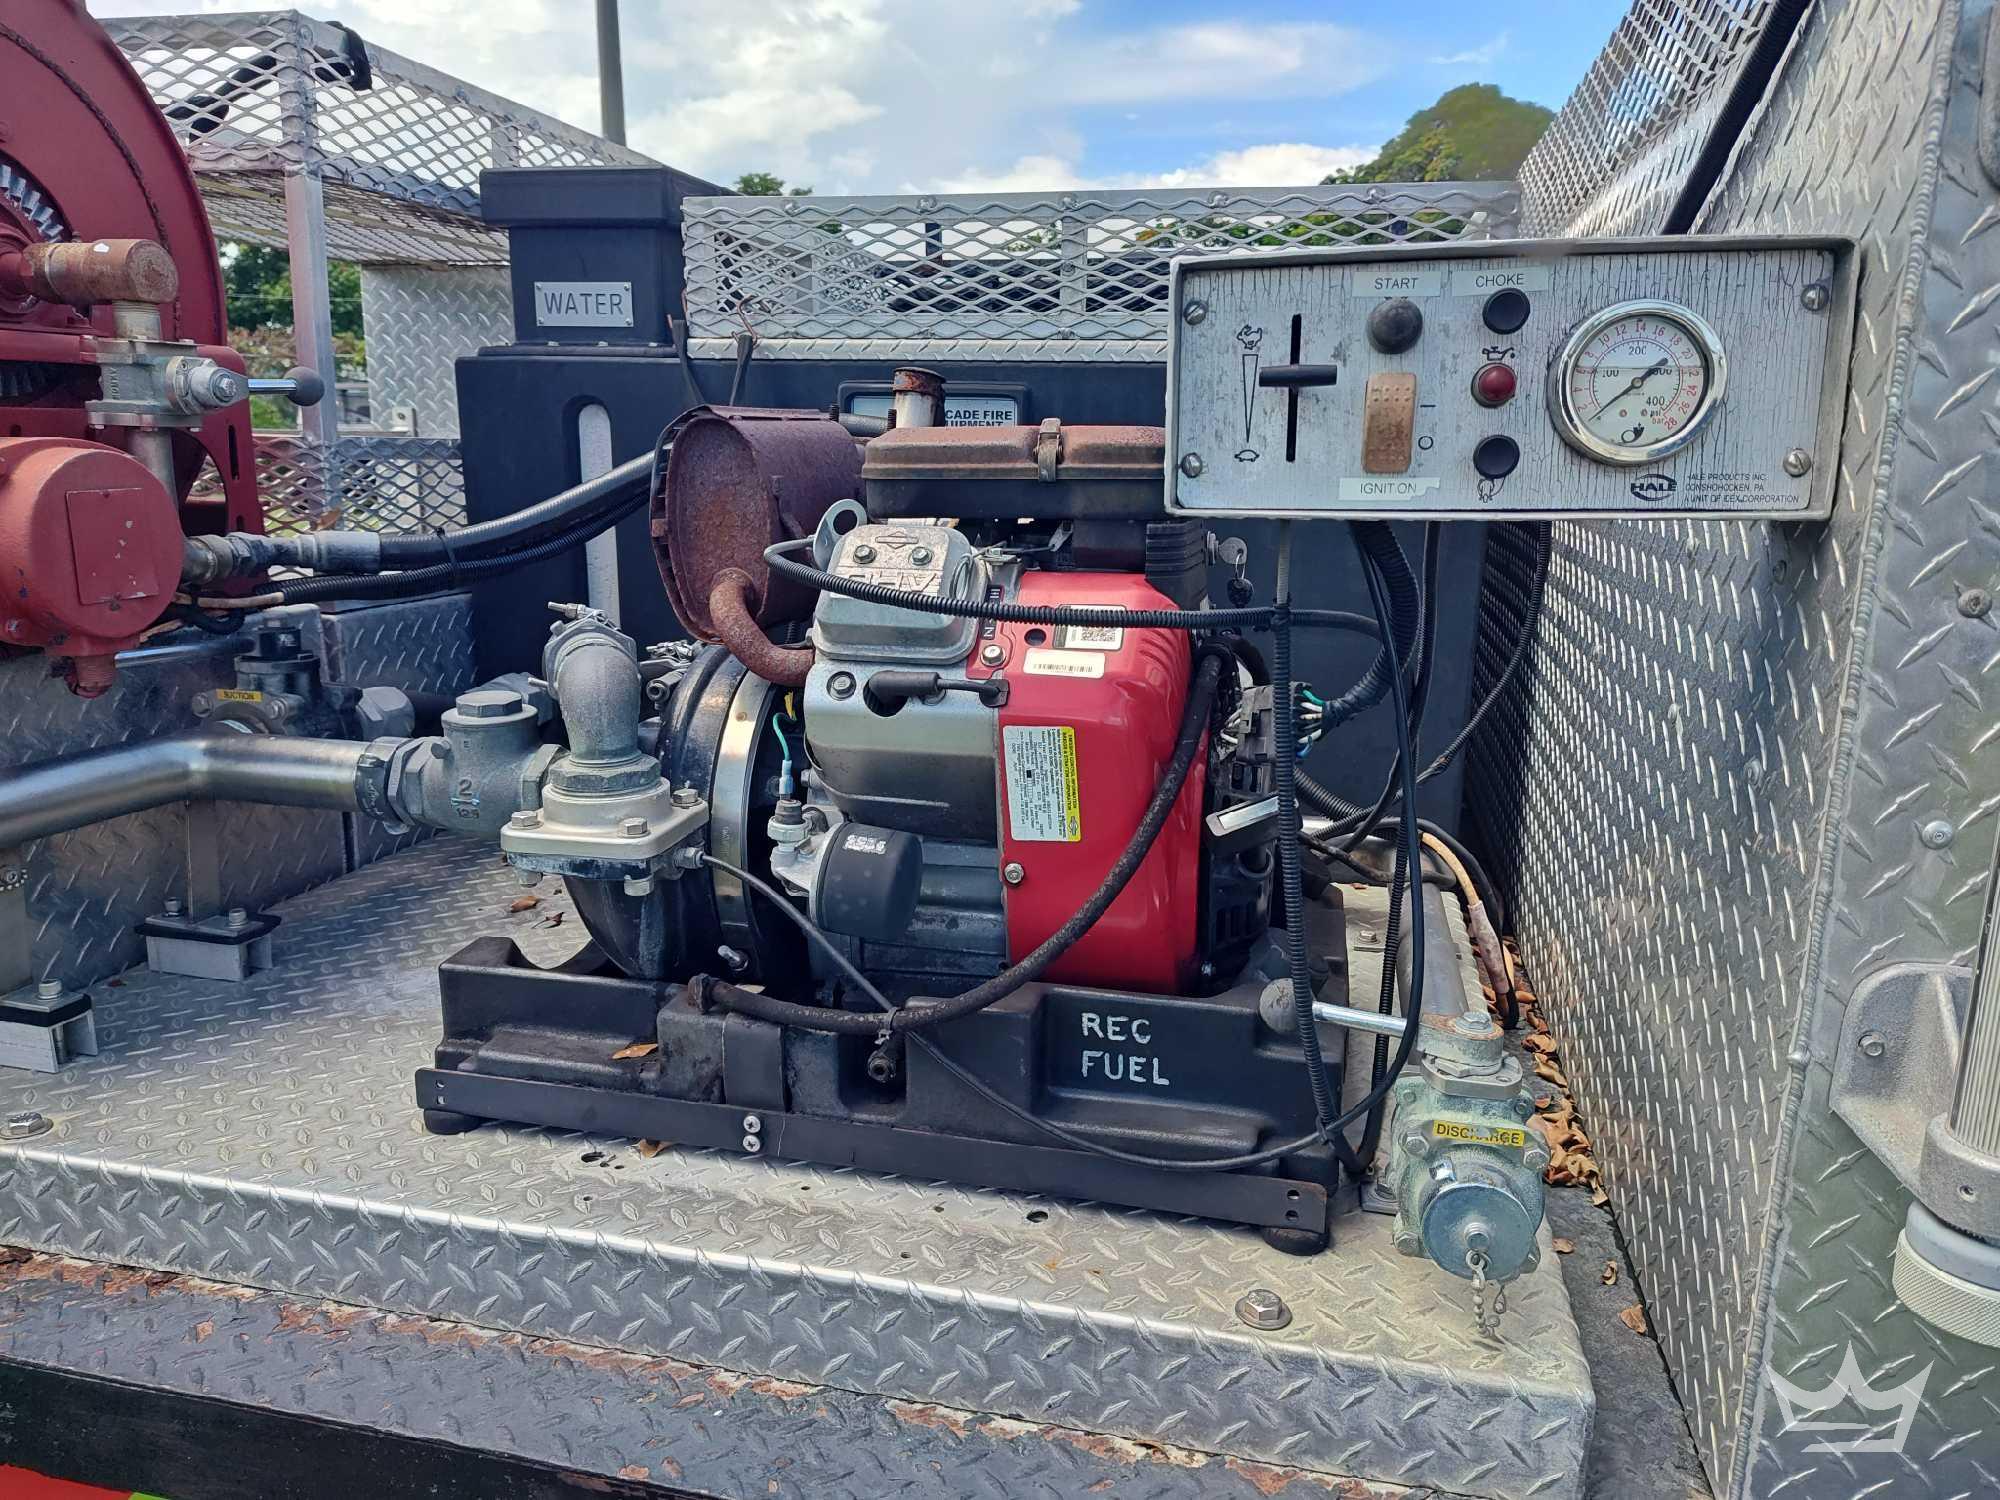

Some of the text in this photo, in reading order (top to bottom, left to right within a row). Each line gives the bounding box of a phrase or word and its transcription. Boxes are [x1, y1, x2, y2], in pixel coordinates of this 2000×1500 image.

[1374, 277, 1419, 290] START
[1475, 273, 1525, 288] CHOKE
[543, 292, 625, 316] WATER
[1616, 324, 1628, 336] 12
[1652, 324, 1666, 337] 16
[1628, 345, 1647, 356] 200
[1686, 384, 1698, 397] 24
[1646, 395, 1665, 407] 400
[983, 410, 1013, 421] FIRE
[1664, 416, 1678, 431] 28
[1707, 473, 1750, 481] PRODUCTS
[1630, 481, 1677, 493] HALE
[1690, 494, 1709, 502] UNIT
[1711, 494, 1722, 503] OF
[1743, 494, 1800, 503] CORPORATION
[459, 778, 473, 796] 2
[1081, 1012, 1152, 1044] REC
[1081, 1049, 1170, 1086] FUEL
